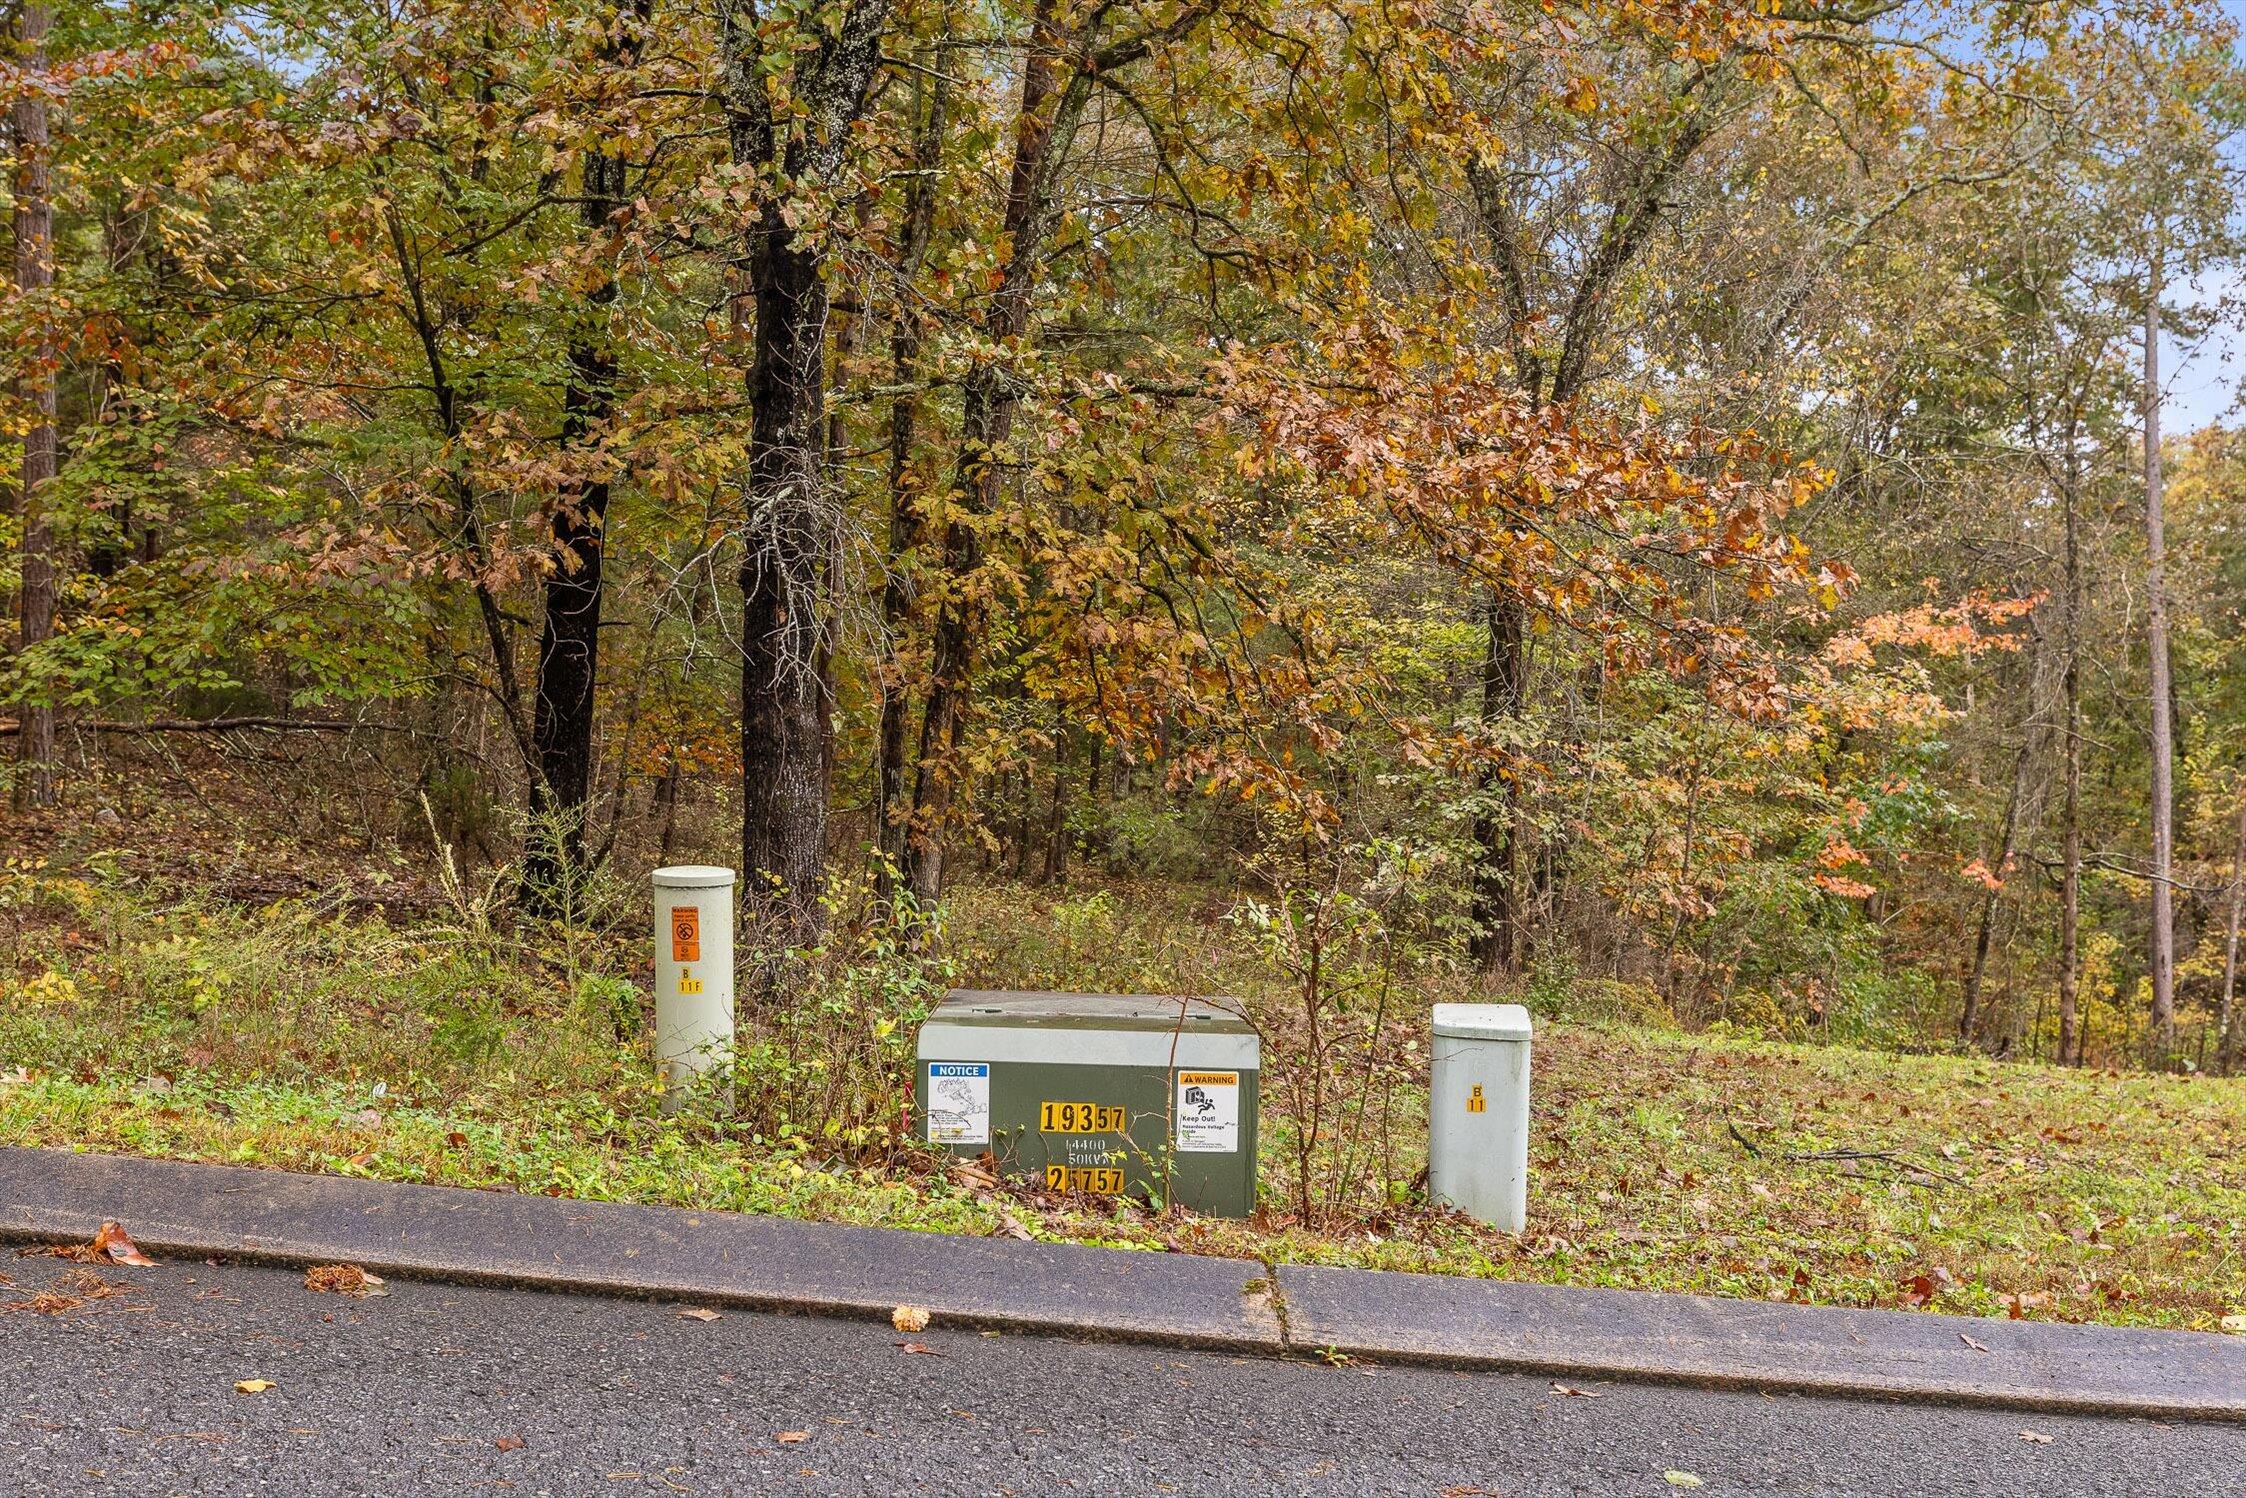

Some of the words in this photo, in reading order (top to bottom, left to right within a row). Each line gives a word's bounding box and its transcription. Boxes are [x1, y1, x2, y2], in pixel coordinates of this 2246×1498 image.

[683, 969, 689, 979] B
[681, 982, 700, 992] 11F
[940, 1066, 979, 1076] NOTICE
[1194, 1076, 1234, 1084] WARNING
[1474, 1087, 1481, 1097] B
[1470, 1100, 1483, 1112] 11
[1044, 1104, 1123, 1131] 19357
[1182, 1115, 1200, 1123] Keep
[1065, 1139, 1106, 1150] 14400
[1050, 1167, 1122, 1193] 25757
